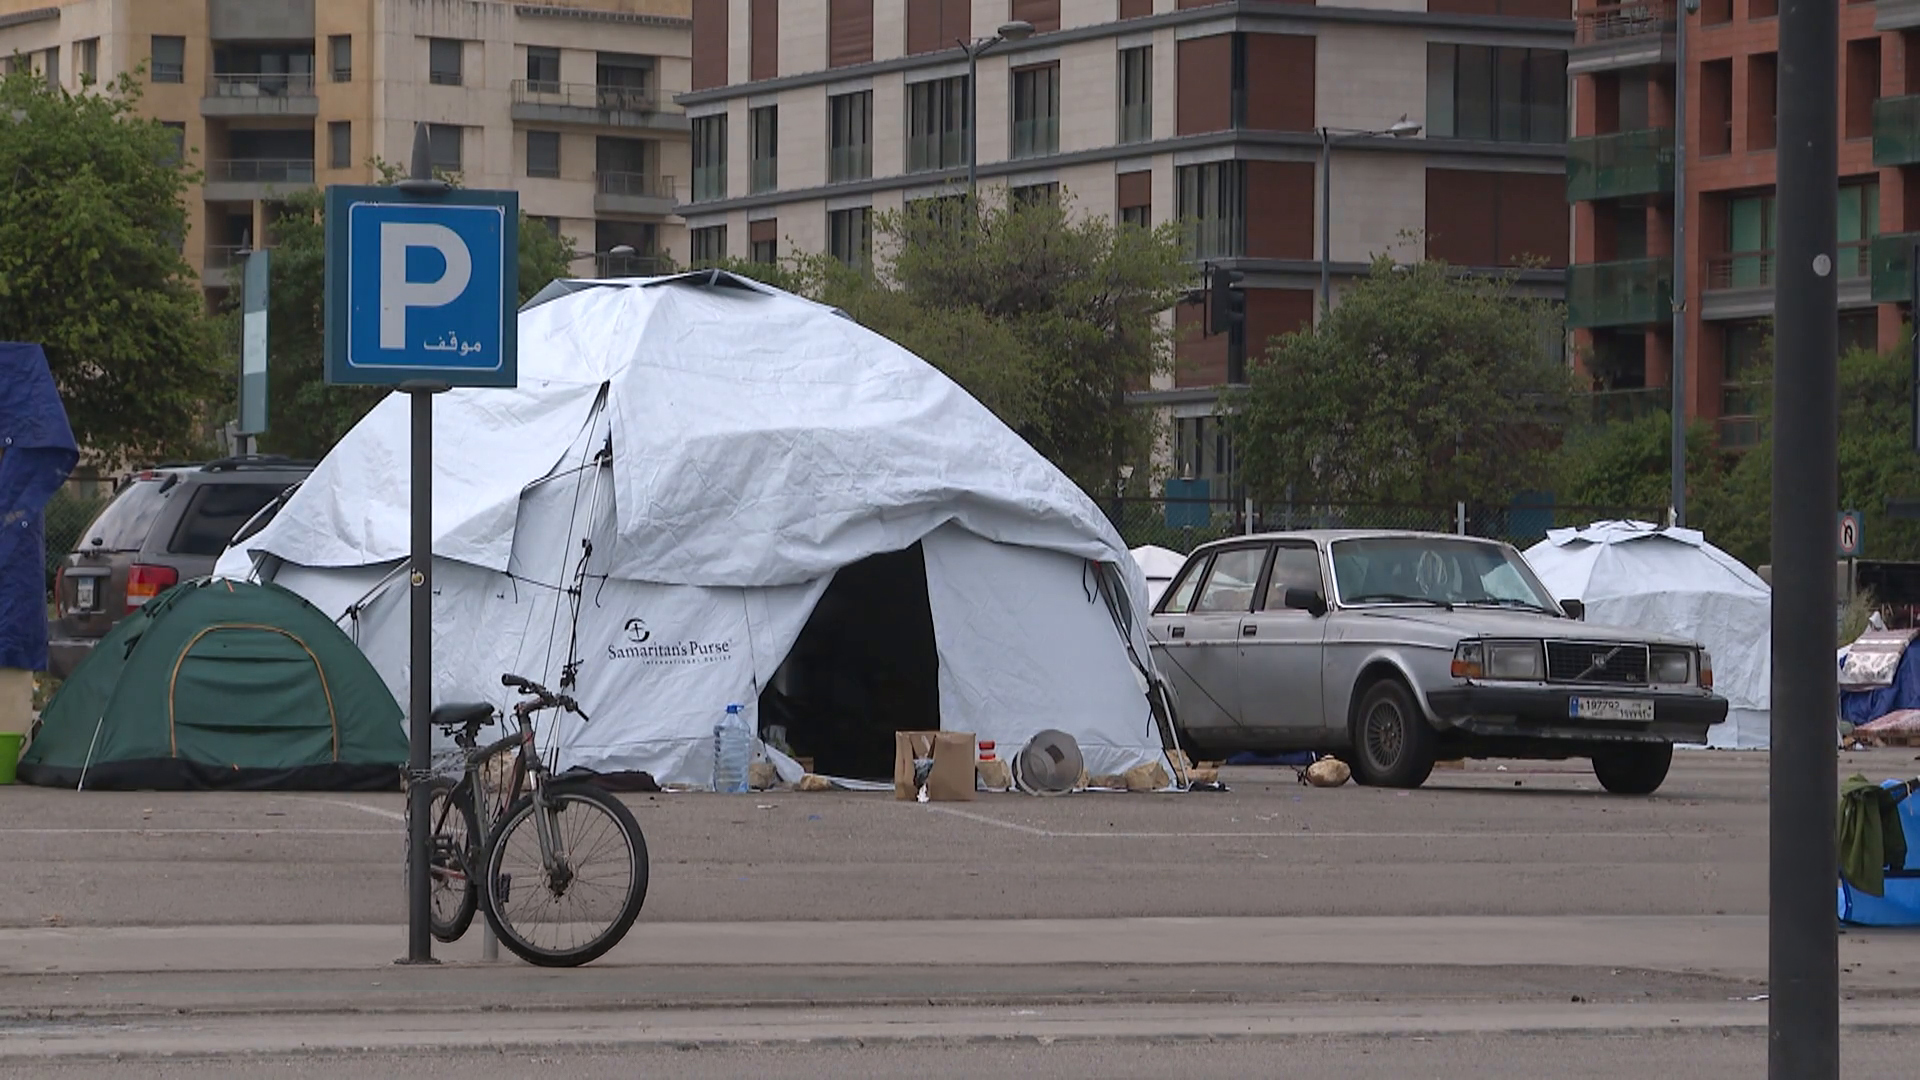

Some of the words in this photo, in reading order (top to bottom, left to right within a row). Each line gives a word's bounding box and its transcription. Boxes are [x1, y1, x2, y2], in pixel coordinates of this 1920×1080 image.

[380, 221, 472, 349] P
[423, 330, 482, 356] موقف
[608, 642, 688, 660] Samaritan's
[689, 641, 729, 656] Purse
